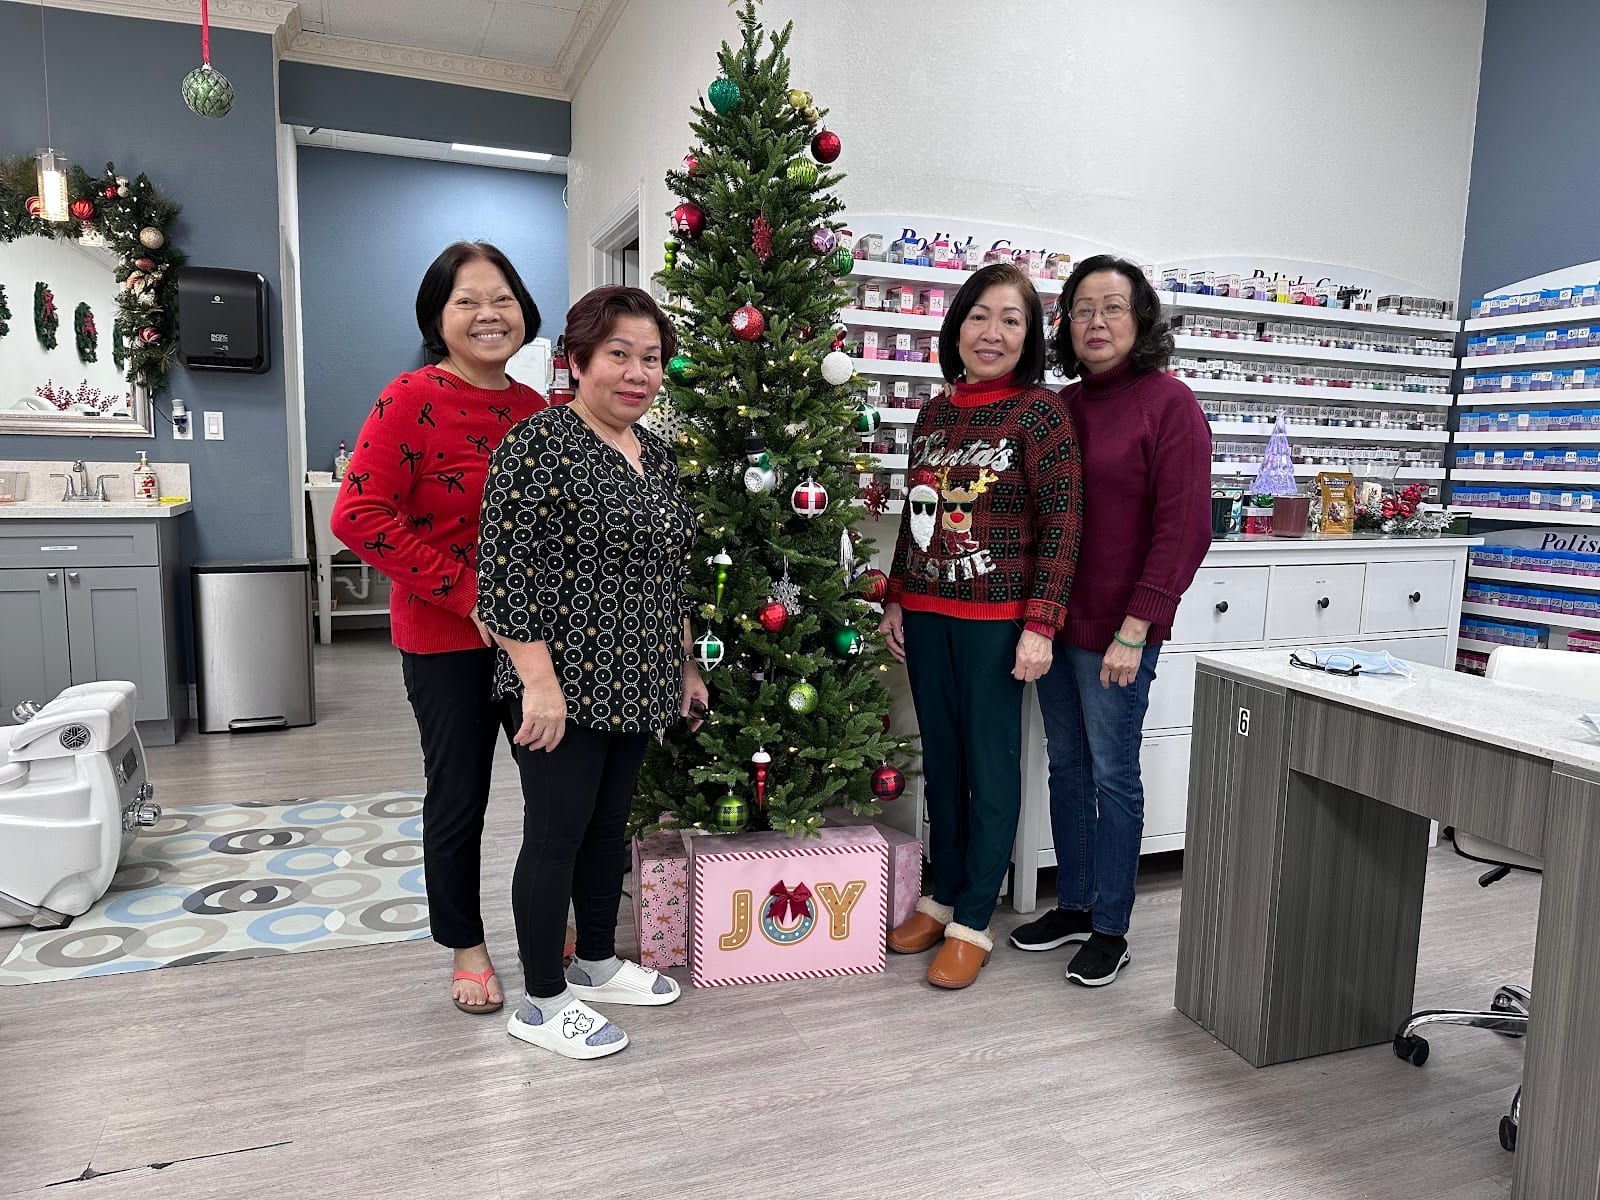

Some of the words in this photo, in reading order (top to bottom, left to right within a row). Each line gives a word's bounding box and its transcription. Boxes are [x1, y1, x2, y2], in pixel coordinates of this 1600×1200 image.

[896, 228, 974, 254] Pols
[991, 239, 1058, 262] Cete
[1316, 278, 1371, 300] Cnter
[911, 429, 1013, 471] Santa's
[1541, 532, 1600, 553] Polis
[907, 548, 997, 582] ESTIE
[1240, 710, 1248, 733] 6
[719, 880, 867, 952] JOY
